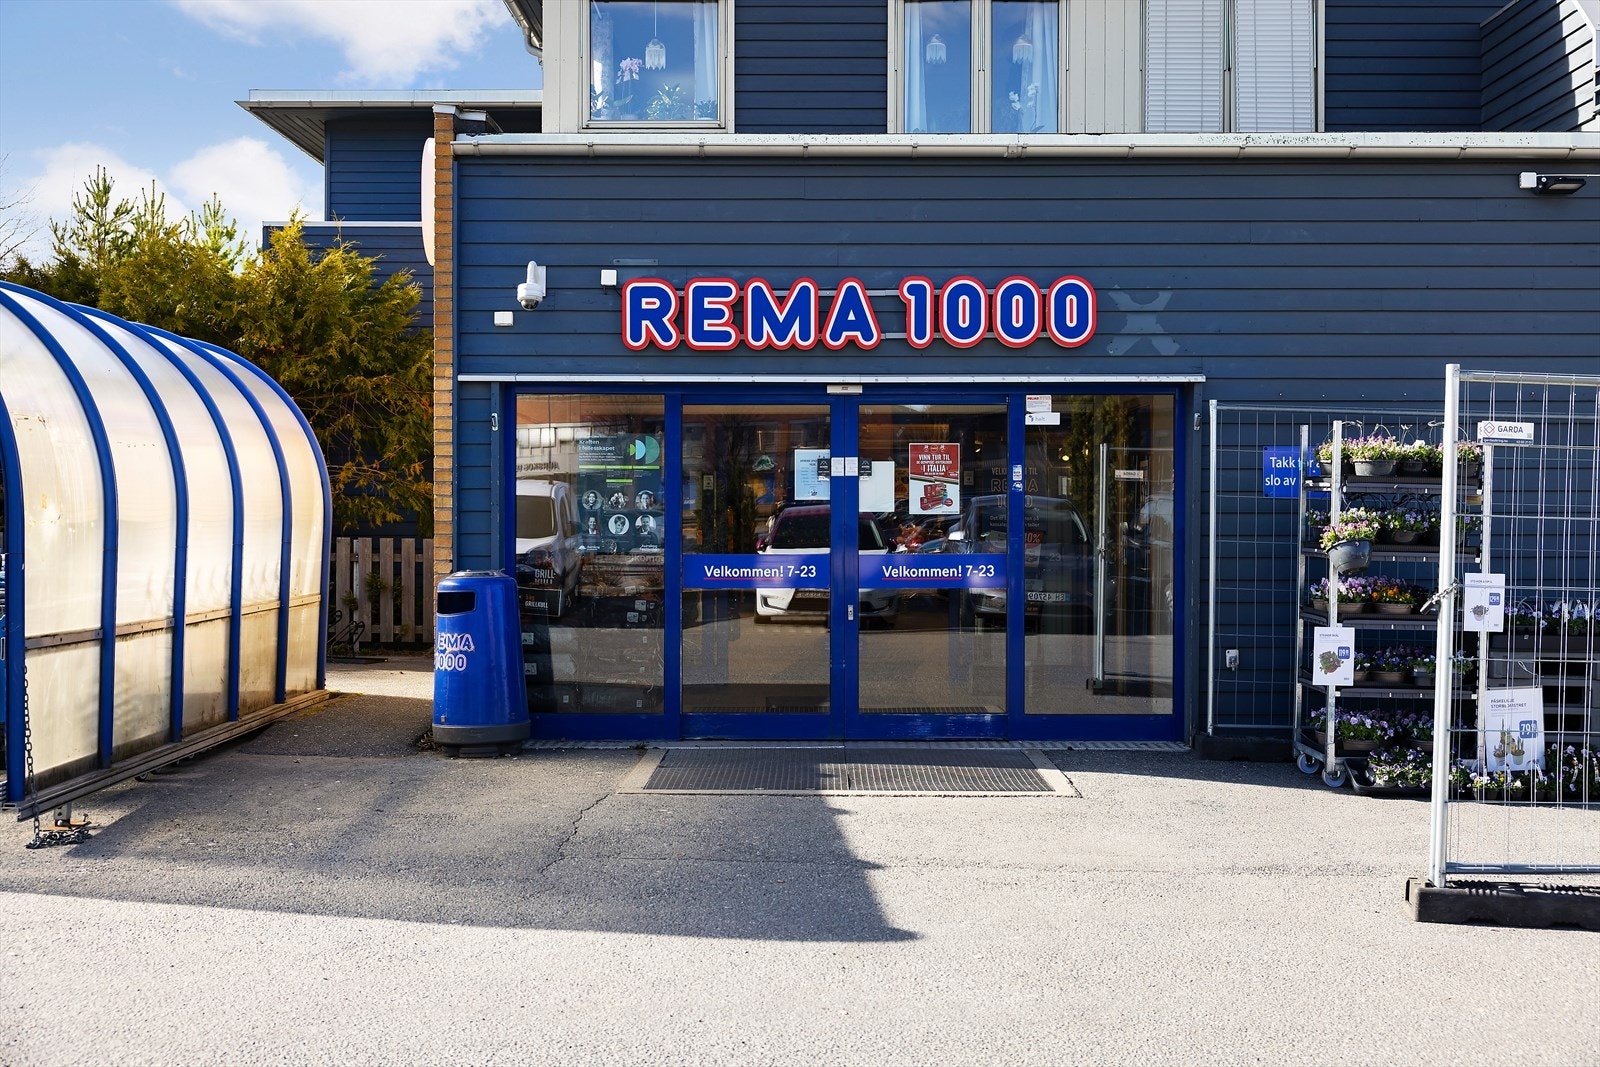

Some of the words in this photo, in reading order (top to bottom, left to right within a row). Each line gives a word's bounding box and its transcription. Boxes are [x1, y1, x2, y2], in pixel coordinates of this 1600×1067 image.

[622, 277, 881, 350] REMA
[900, 276, 1097, 349] 1000
[1497, 425, 1524, 434] GARDA
[1269, 456, 1296, 468] Takk
[991, 478, 1039, 493] REA
[1265, 474, 1281, 486] slo
[1283, 477, 1296, 486] av
[704, 565, 784, 577] Velkommen!
[787, 565, 817, 578] 7-23
[882, 565, 962, 578] Velkommen!
[965, 564, 995, 577] 7-23
[434, 632, 475, 652] EMA
[1520, 723, 1531, 735] 79
